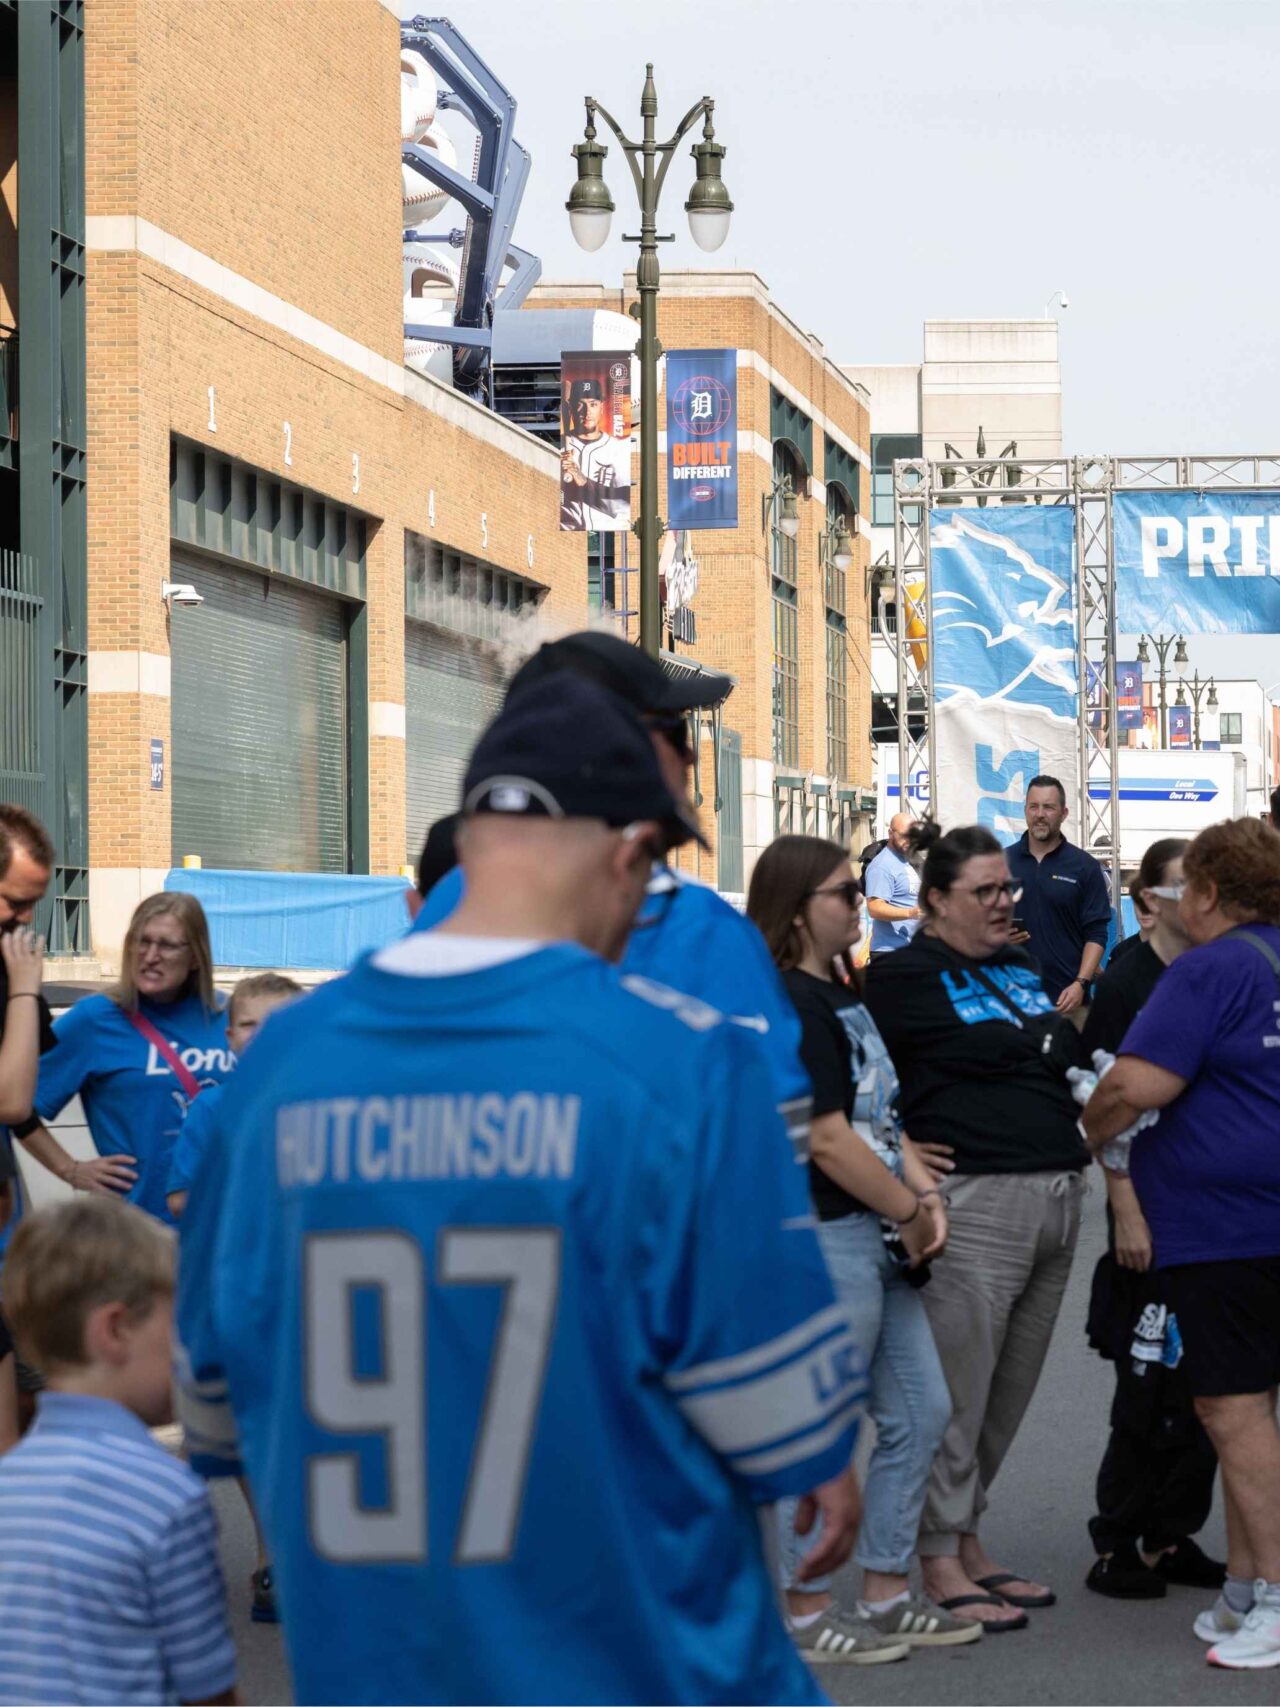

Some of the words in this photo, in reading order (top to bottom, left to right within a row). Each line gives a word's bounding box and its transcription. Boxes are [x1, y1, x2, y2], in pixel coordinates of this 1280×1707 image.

[207, 386, 217, 433] 1
[283, 421, 292, 466] 2
[672, 442, 732, 466] BUILT
[352, 453, 360, 494] 3
[673, 465, 732, 480] DIFFERENT
[428, 488, 436, 528] 4
[481, 512, 489, 549] 5
[527, 533, 535, 568] 6
[1169, 792, 1183, 800] One
[1184, 792, 1201, 802] Way
[1175, 780, 1196, 788] Local
[275, 1094, 581, 1188] HUTCHINSON
[303, 1225, 564, 1566] 97
